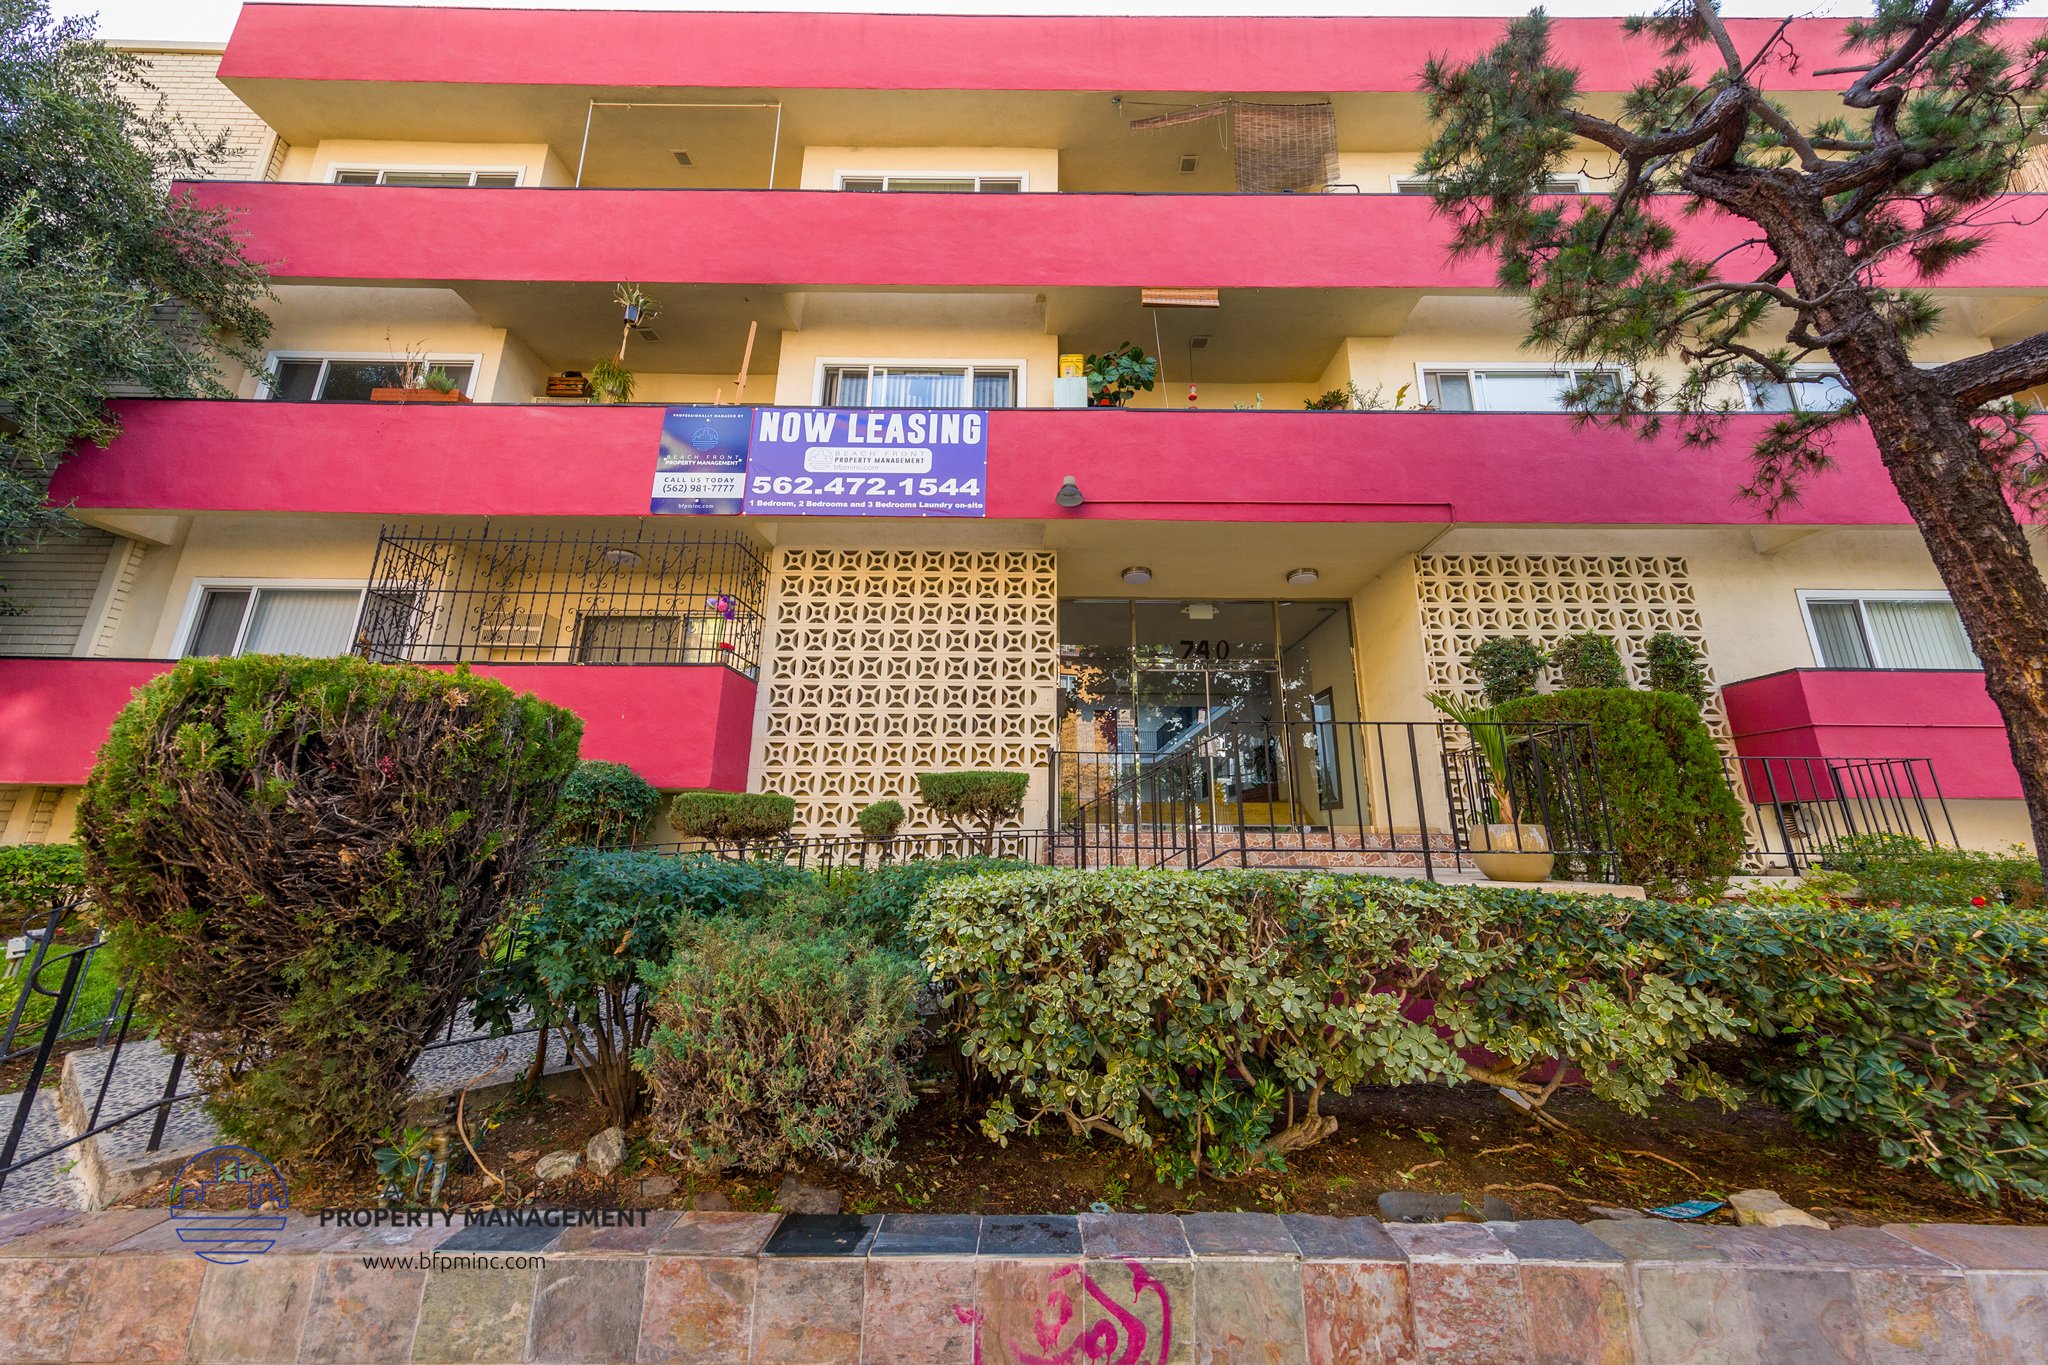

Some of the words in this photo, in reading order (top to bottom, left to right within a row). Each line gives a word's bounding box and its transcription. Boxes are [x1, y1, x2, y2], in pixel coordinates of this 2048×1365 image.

[759, 411, 837, 443] NOW
[847, 413, 982, 445] LEASING
[662, 484, 687, 493] (562)
[690, 484, 735, 493] 981-7777
[751, 476, 980, 496] 562.472.1544
[757, 500, 797, 508] Bedroom,
[1180, 640, 1230, 660] 740
